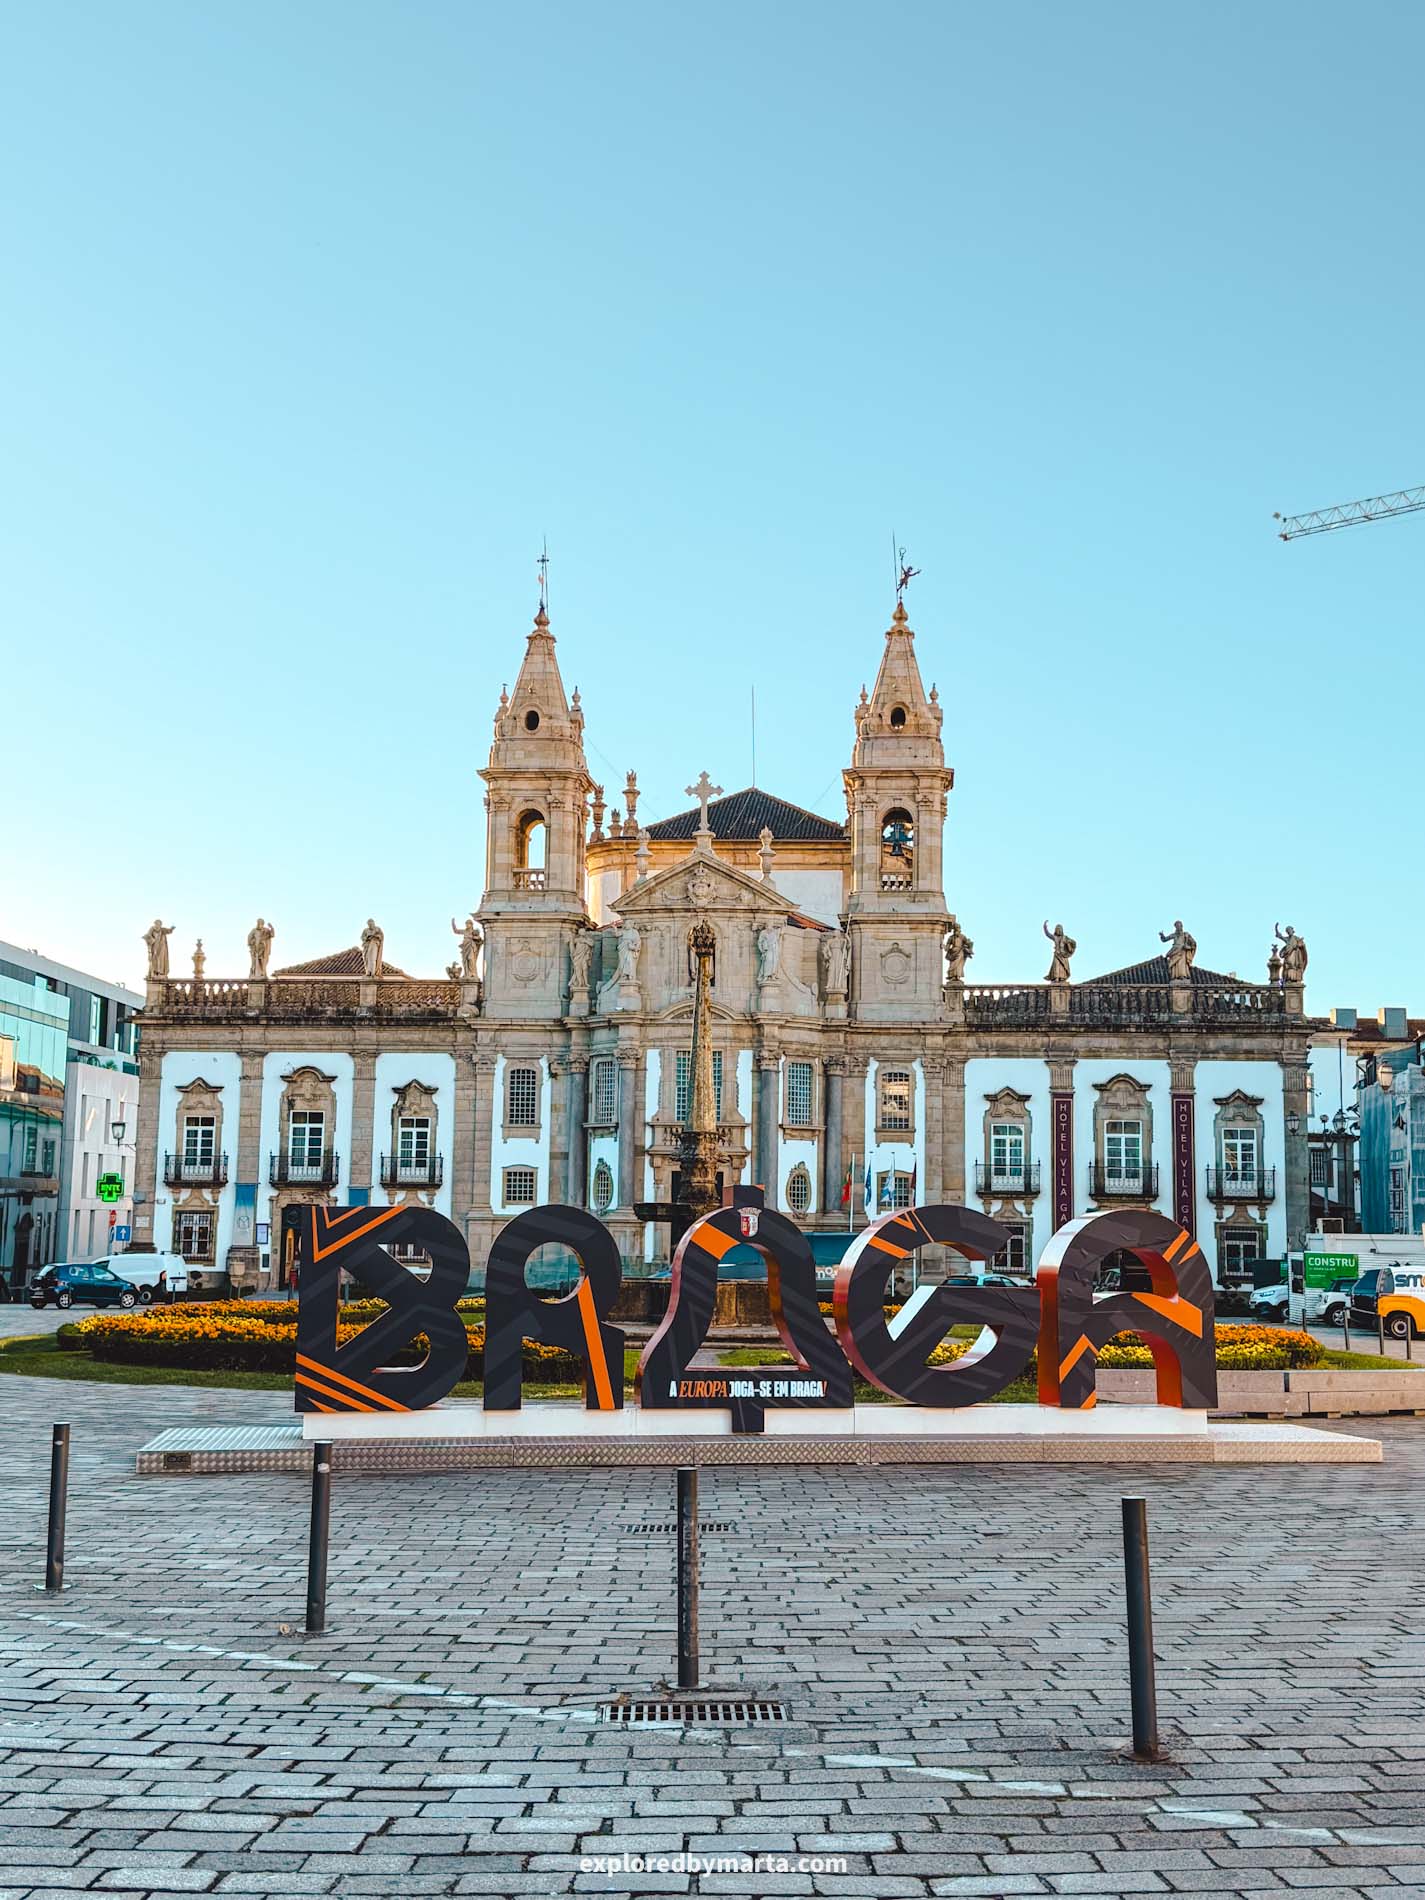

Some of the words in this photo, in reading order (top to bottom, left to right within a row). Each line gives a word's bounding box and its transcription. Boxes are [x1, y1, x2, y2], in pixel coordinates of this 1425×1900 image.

[1059, 1103, 1068, 1152] HOTEL
[1179, 1103, 1188, 1153] HOTEL
[1059, 1158, 1068, 1197] VILA
[1180, 1159, 1189, 1198] VILA
[1308, 1257, 1356, 1267] CONSTRU
[669, 1380, 678, 1398] A
[679, 1380, 727, 1398] EUROPA
[728, 1380, 773, 1398] JOGA-SE
[773, 1380, 789, 1398] EM
[790, 1380, 828, 1398] BRAGA!
